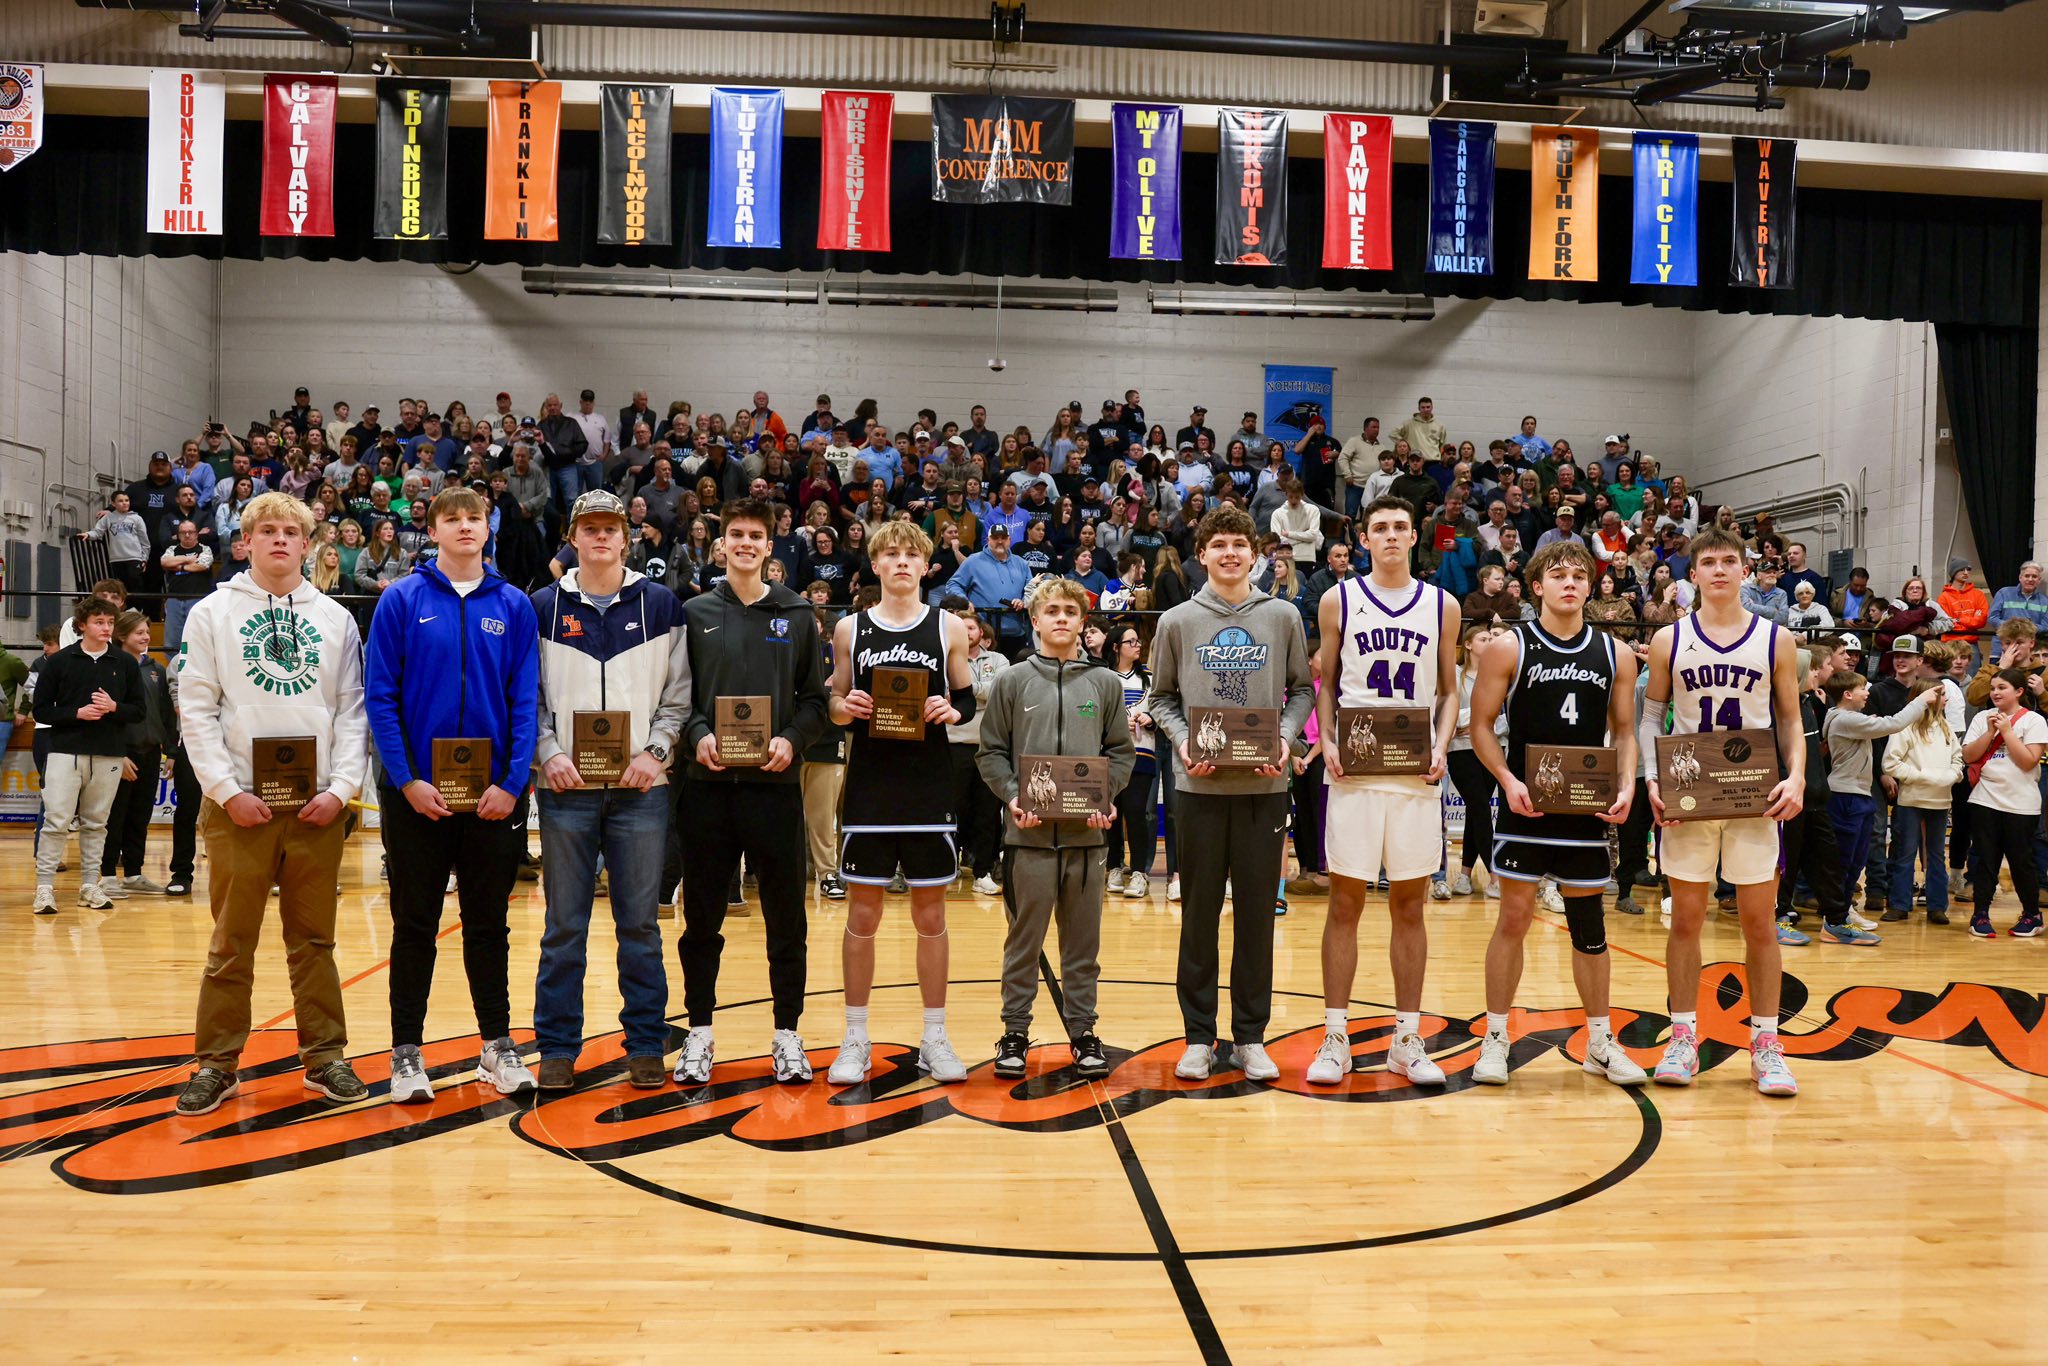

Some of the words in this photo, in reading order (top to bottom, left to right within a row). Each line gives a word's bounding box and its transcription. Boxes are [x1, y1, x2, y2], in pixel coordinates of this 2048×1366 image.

[7, 65, 33, 89] HOLIDAY
[0, 125, 25, 136] 983
[179, 73, 195, 205] BUNKER
[963, 117, 1042, 154] MSM
[1135, 110, 1159, 149] MT
[287, 81, 310, 234] CALVARY
[401, 89, 422, 235] EDINBURG
[515, 81, 532, 240] FRANKLIN
[623, 91, 648, 241] LINCOLNWOOD
[734, 94, 756, 243] LUTHERAN
[845, 96, 869, 248] MORRISONVILLE
[938, 158, 1068, 182] CONFERENCE
[1555, 133, 1573, 209] SOUTH
[1657, 139, 1674, 197] TRI
[1345, 121, 1370, 264] PAWNEE
[1454, 122, 1468, 253] SANGAMON
[163, 209, 207, 232] HILL
[1136, 157, 1156, 255] OLIVE
[1756, 139, 1772, 287] WAVERLY
[1554, 216, 1572, 278] FORK
[1656, 204, 1674, 283] CITY
[1433, 254, 1485, 273] VALLEY
[1267, 381, 1304, 392] NORTH
[243, 645, 260, 658] 20
[304, 651, 320, 665] 25
[858, 643, 938, 675] Panthers
[1196, 645, 1267, 663] TRIOPIA
[1354, 627, 1429, 657] ROUTT
[245, 667, 318, 697] FOOTBALL
[1367, 660, 1415, 700] 44
[1527, 662, 1607, 690] Panthers
[1680, 664, 1763, 693] ROUTT
[1559, 693, 1579, 725] 4
[1698, 696, 1743, 732] 14
[876, 725, 916, 733] TOURNAMENT
[1708, 770, 1740, 778] WAVERLY
[1741, 768, 1770, 776] HOLIDAY
[1717, 775, 1763, 783] TOURNAMENT
[261, 793, 291, 801] HOLIDAY
